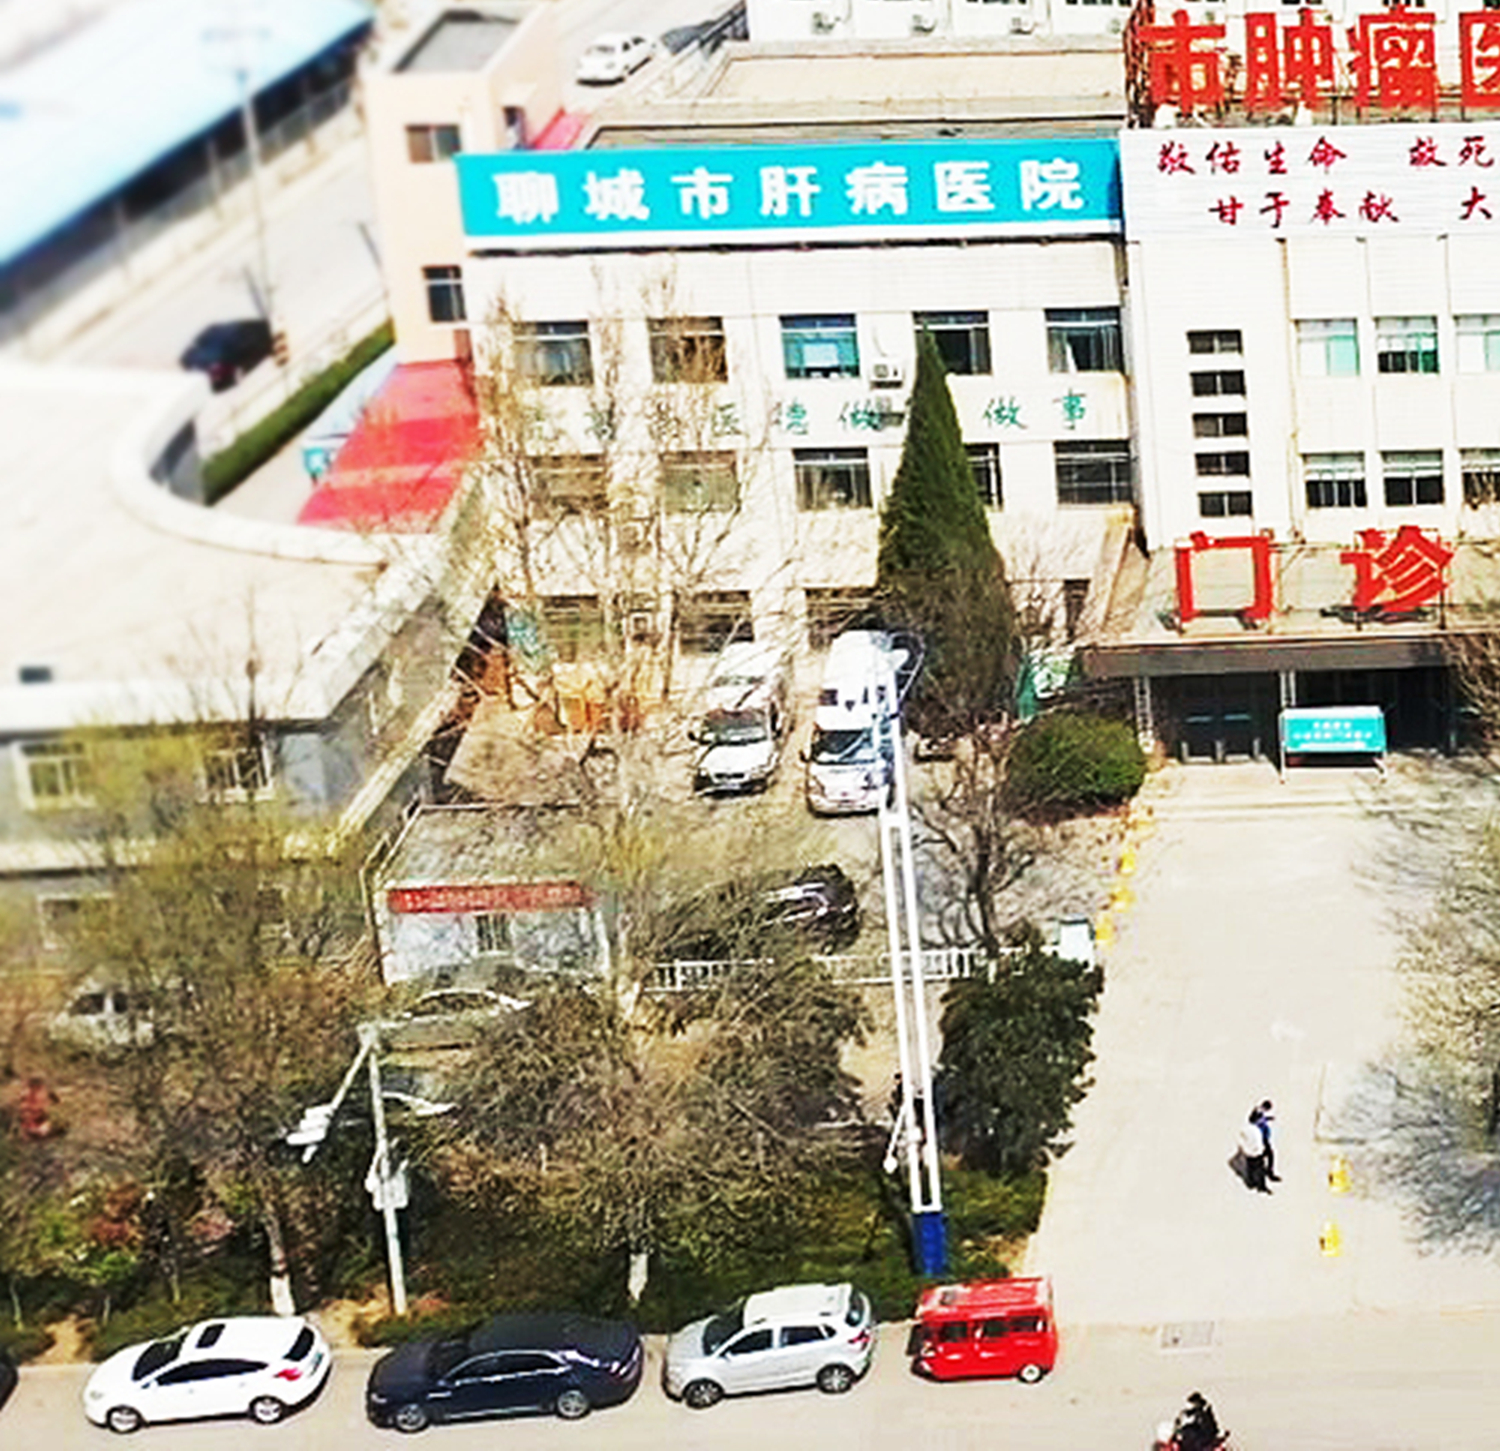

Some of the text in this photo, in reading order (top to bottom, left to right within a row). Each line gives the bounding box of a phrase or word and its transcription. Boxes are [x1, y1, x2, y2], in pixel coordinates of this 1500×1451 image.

[493, 157, 1085, 224] 聊城市肝病医院
